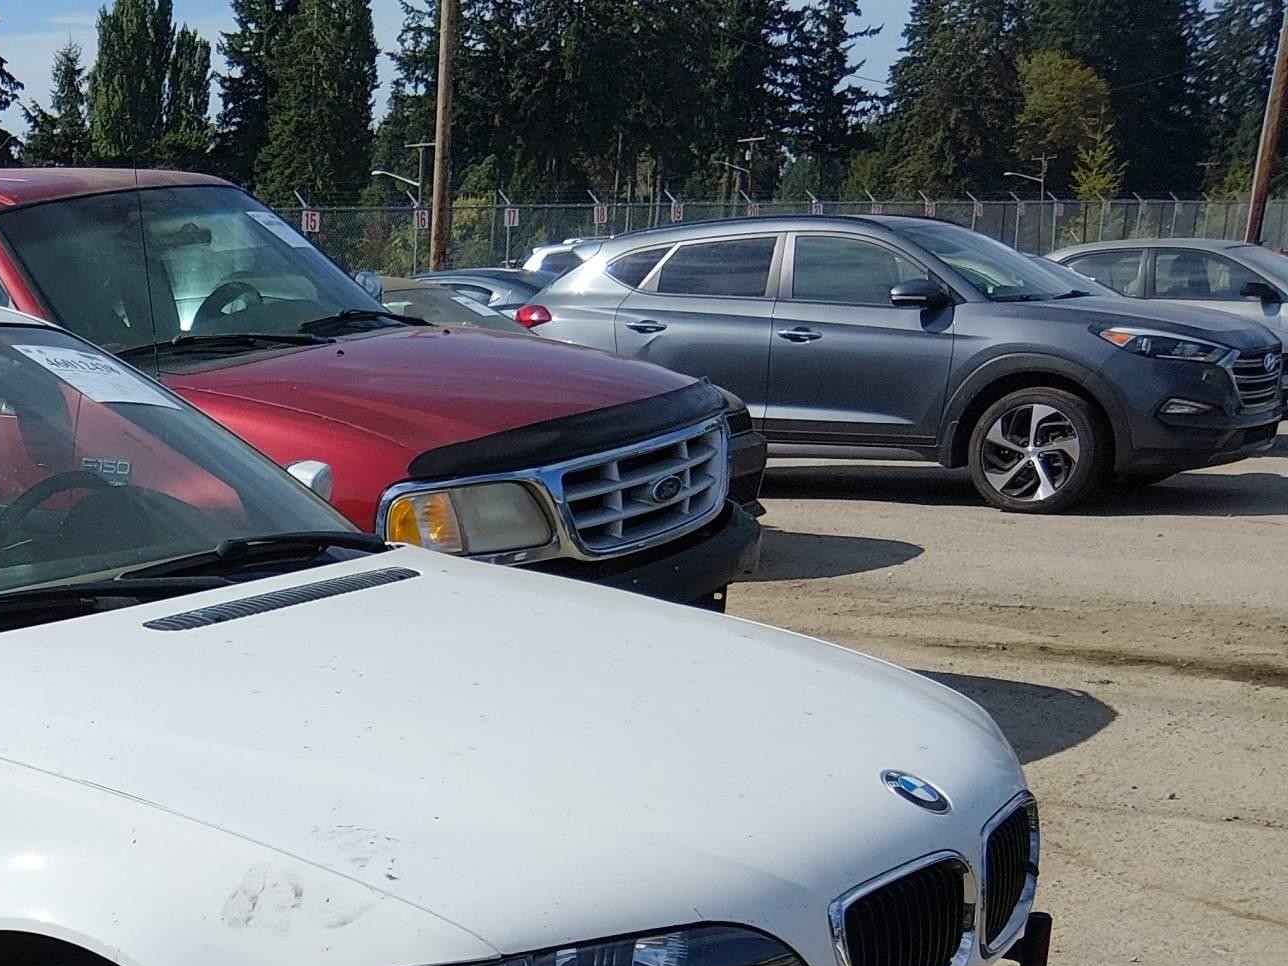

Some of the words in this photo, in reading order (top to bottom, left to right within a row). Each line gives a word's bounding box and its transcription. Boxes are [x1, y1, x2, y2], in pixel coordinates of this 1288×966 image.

[305, 212, 316, 230] 15
[416, 211, 426, 228] 16
[508, 209, 516, 225] 17
